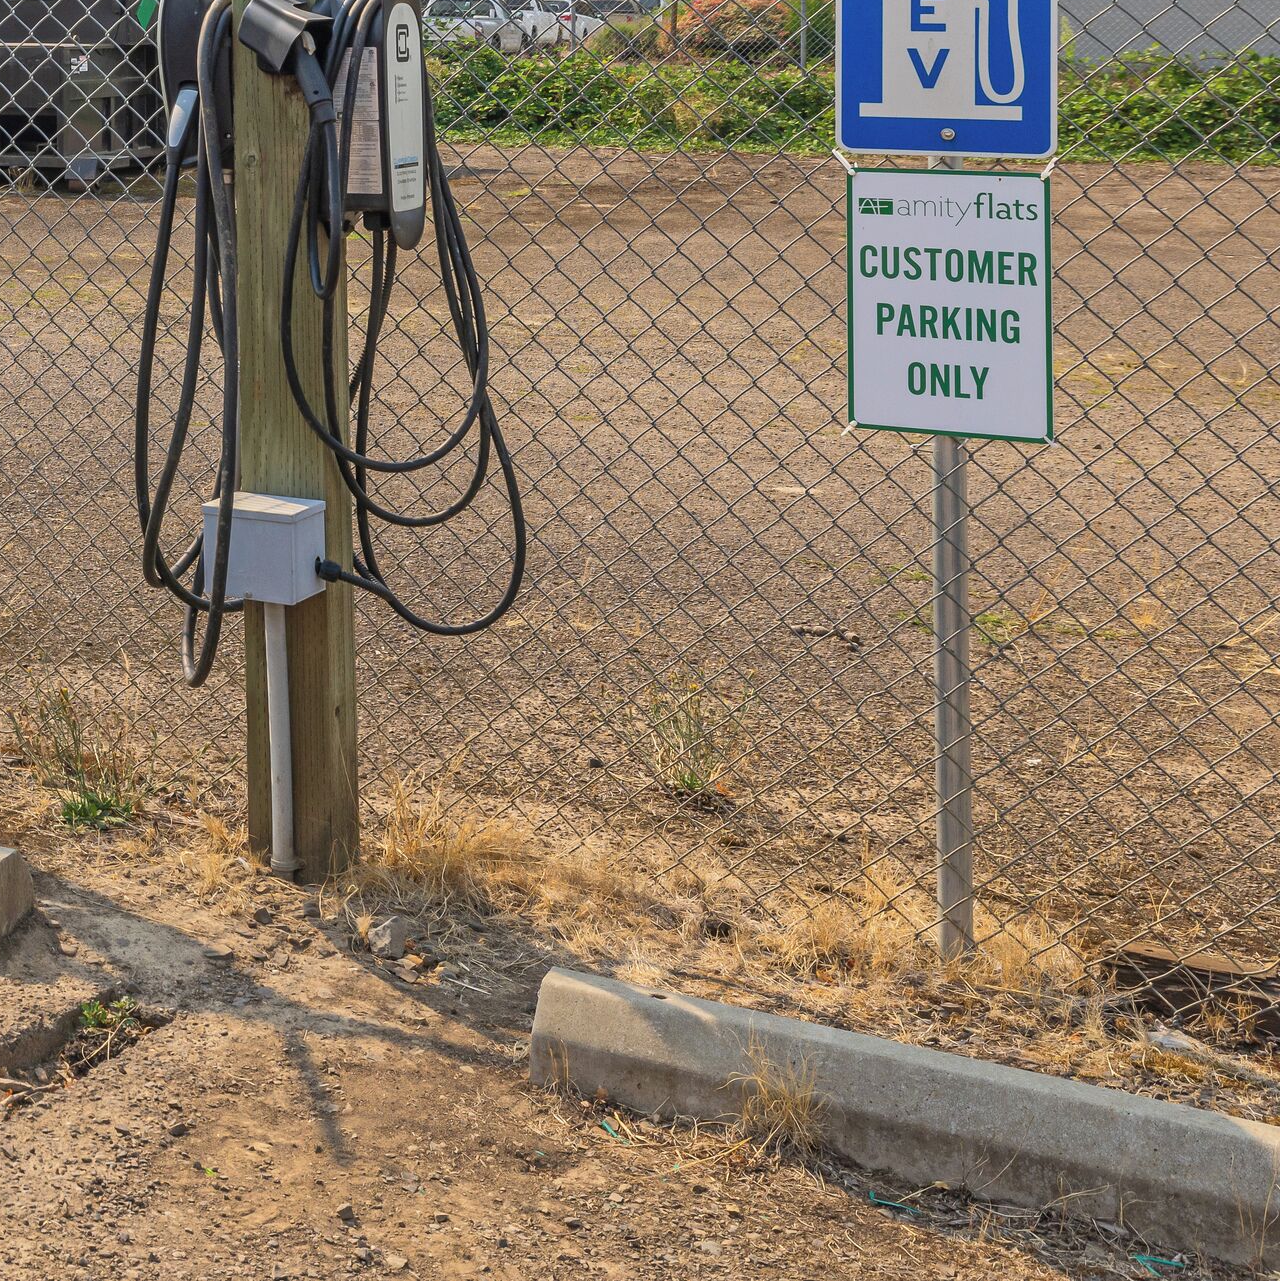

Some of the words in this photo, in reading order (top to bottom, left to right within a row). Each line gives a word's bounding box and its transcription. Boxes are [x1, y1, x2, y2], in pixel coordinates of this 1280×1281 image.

[897, 193, 1039, 226] amityflats
[860, 245, 1038, 286] CUSTOMER
[876, 302, 1021, 344] PARKING
[907, 361, 990, 400] ONLY
